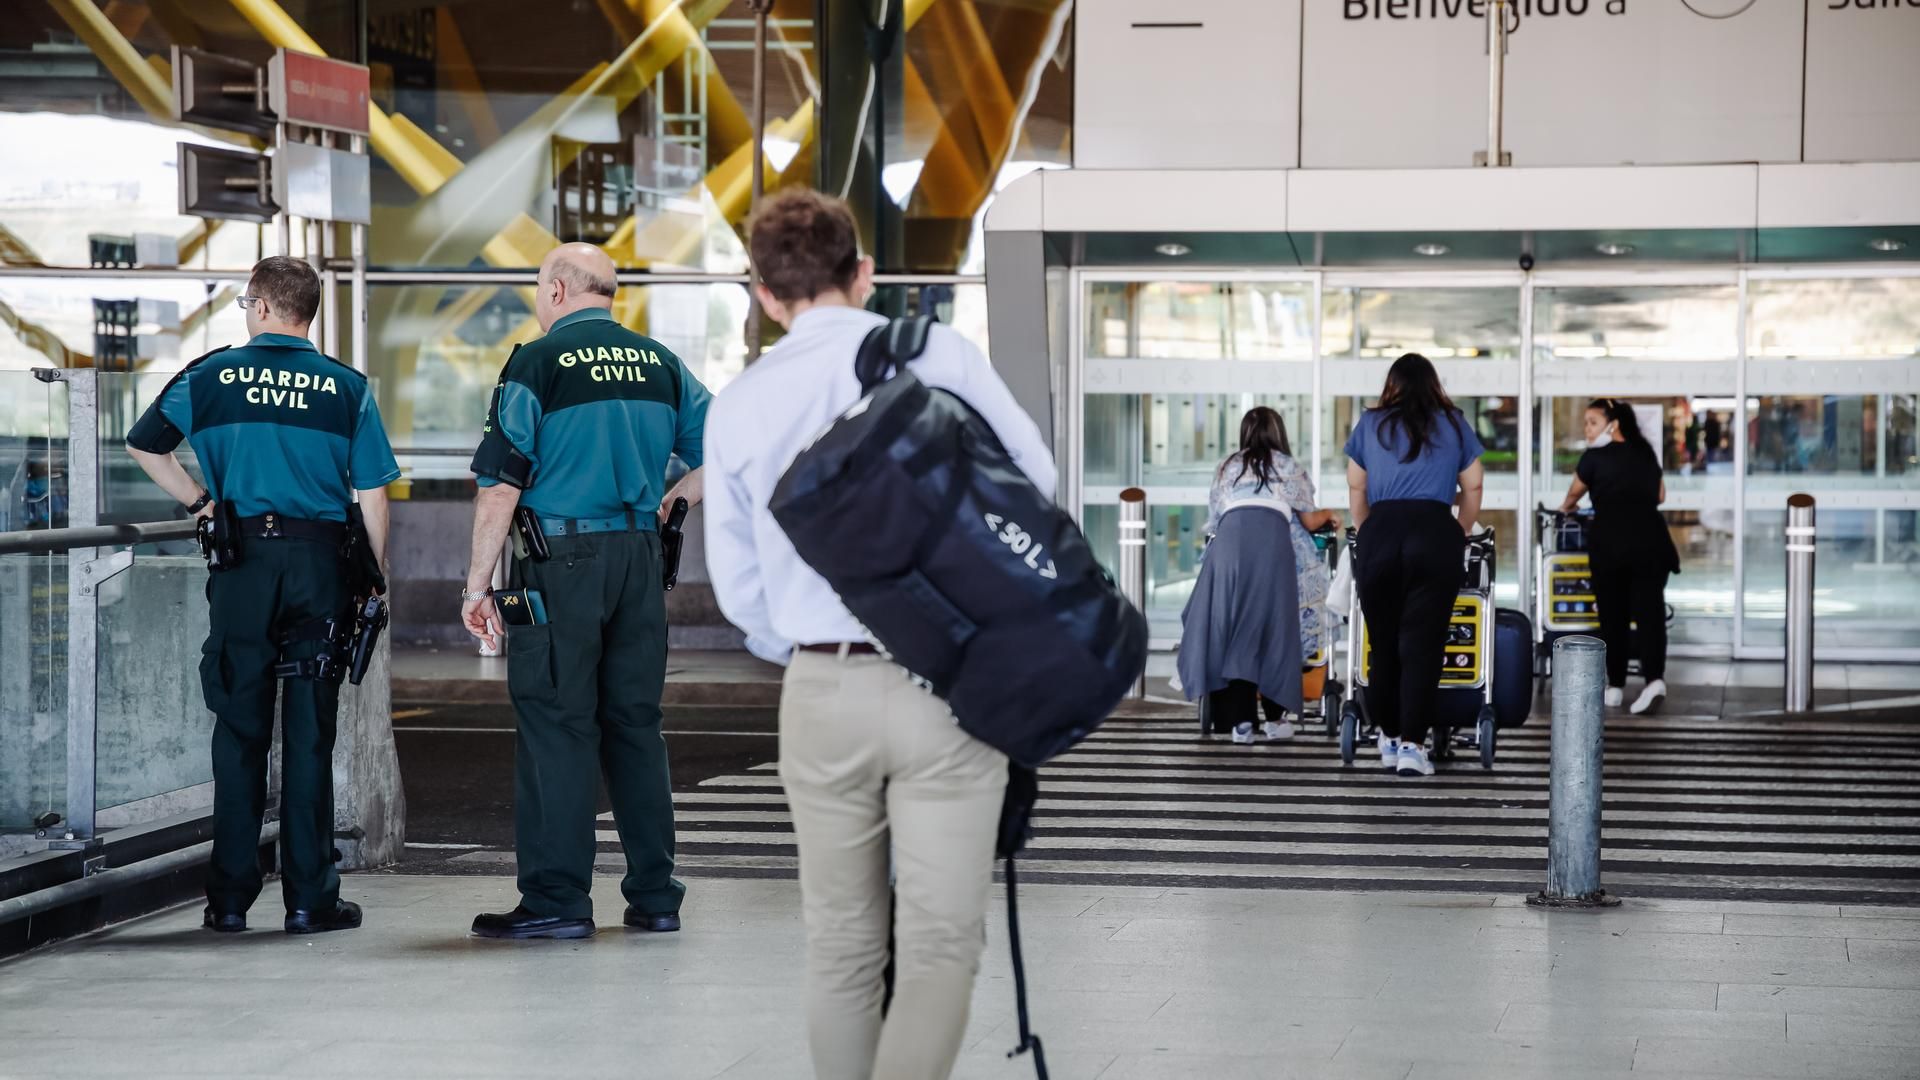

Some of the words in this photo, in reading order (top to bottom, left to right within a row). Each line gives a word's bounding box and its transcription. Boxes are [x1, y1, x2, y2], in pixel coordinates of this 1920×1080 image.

[558, 346, 661, 368] GUARDIA
[219, 367, 337, 395] GUARDIA
[590, 365, 646, 382] CIVIL
[246, 387, 309, 409] CIVIL
